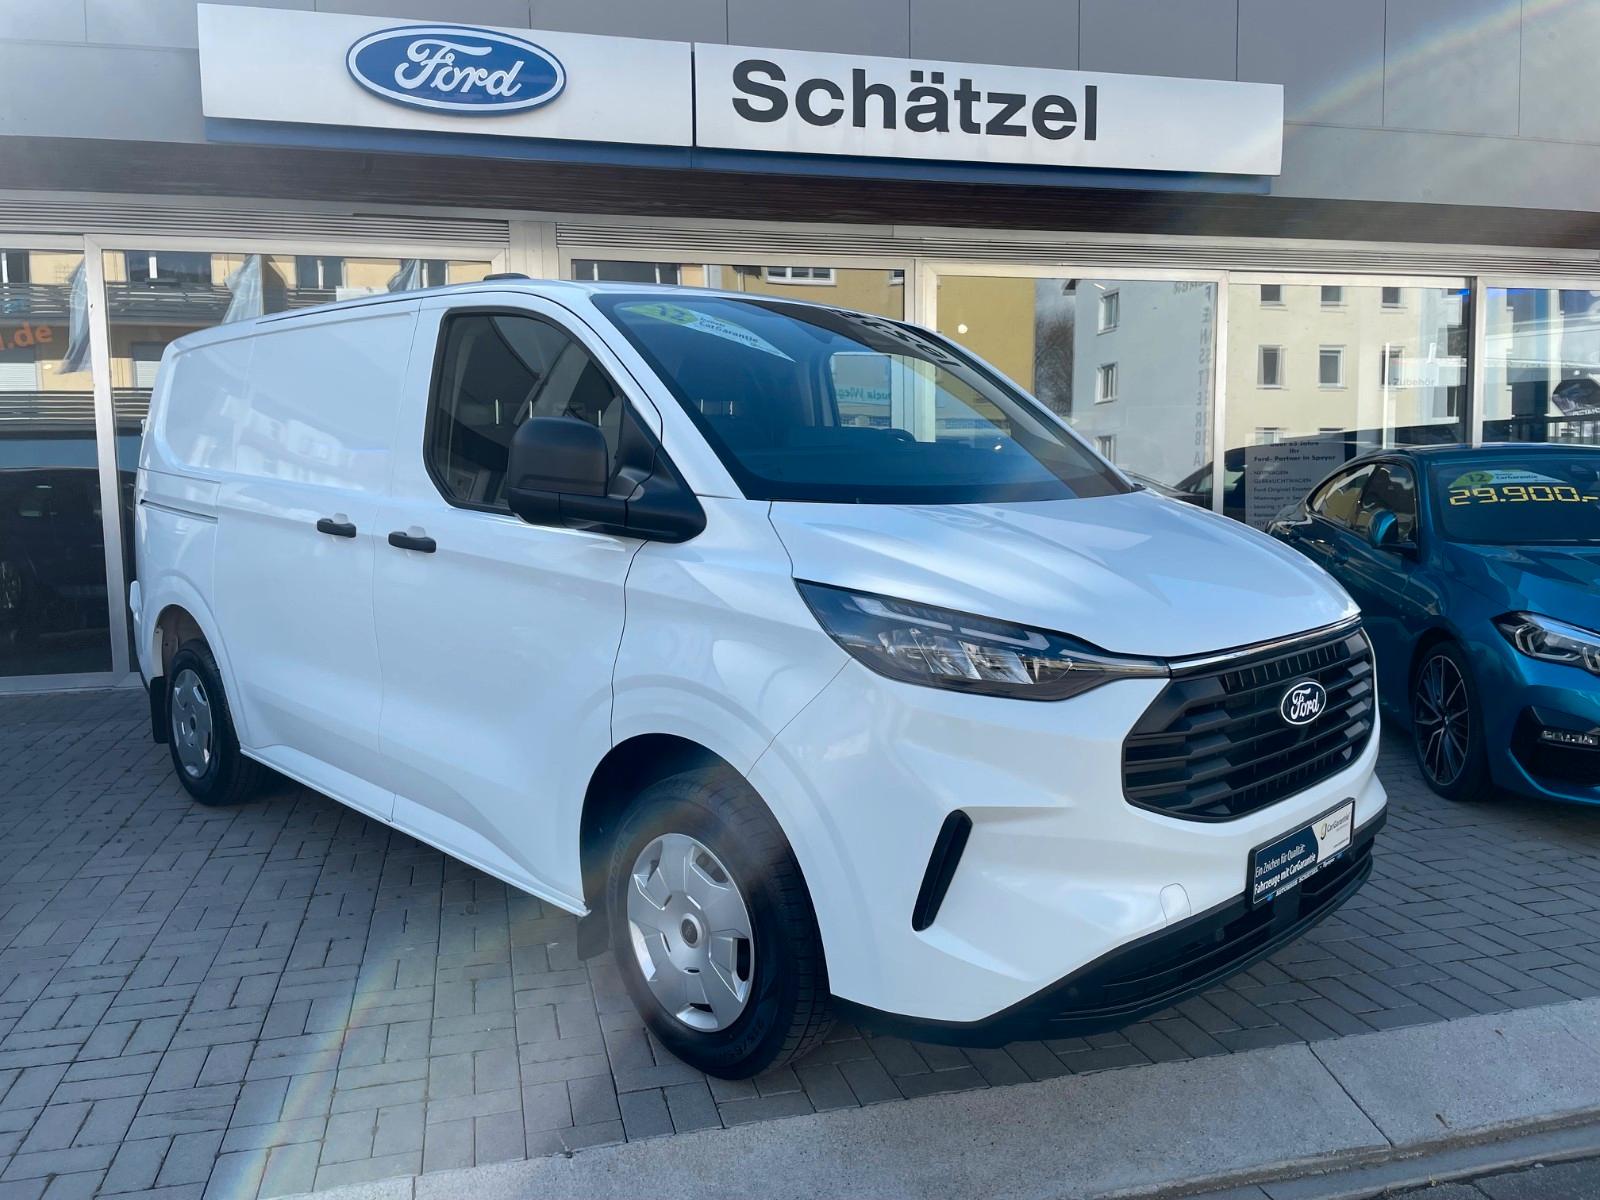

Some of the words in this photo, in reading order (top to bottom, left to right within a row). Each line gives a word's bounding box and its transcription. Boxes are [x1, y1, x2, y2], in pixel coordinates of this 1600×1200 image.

[394, 38, 524, 96] Ford
[731, 58, 1098, 141] Schätzel
[0, 320, 53, 351] .de
[1290, 687, 1320, 720] Ford
[1255, 865, 1263, 878] Ein
[1263, 856, 1281, 875] Zeichen
[1280, 850, 1288, 865] für
[1255, 874, 1281, 895] Fahrzeuge
[1280, 867, 1290, 881] mit
[1289, 852, 1317, 876] CarGarantie
